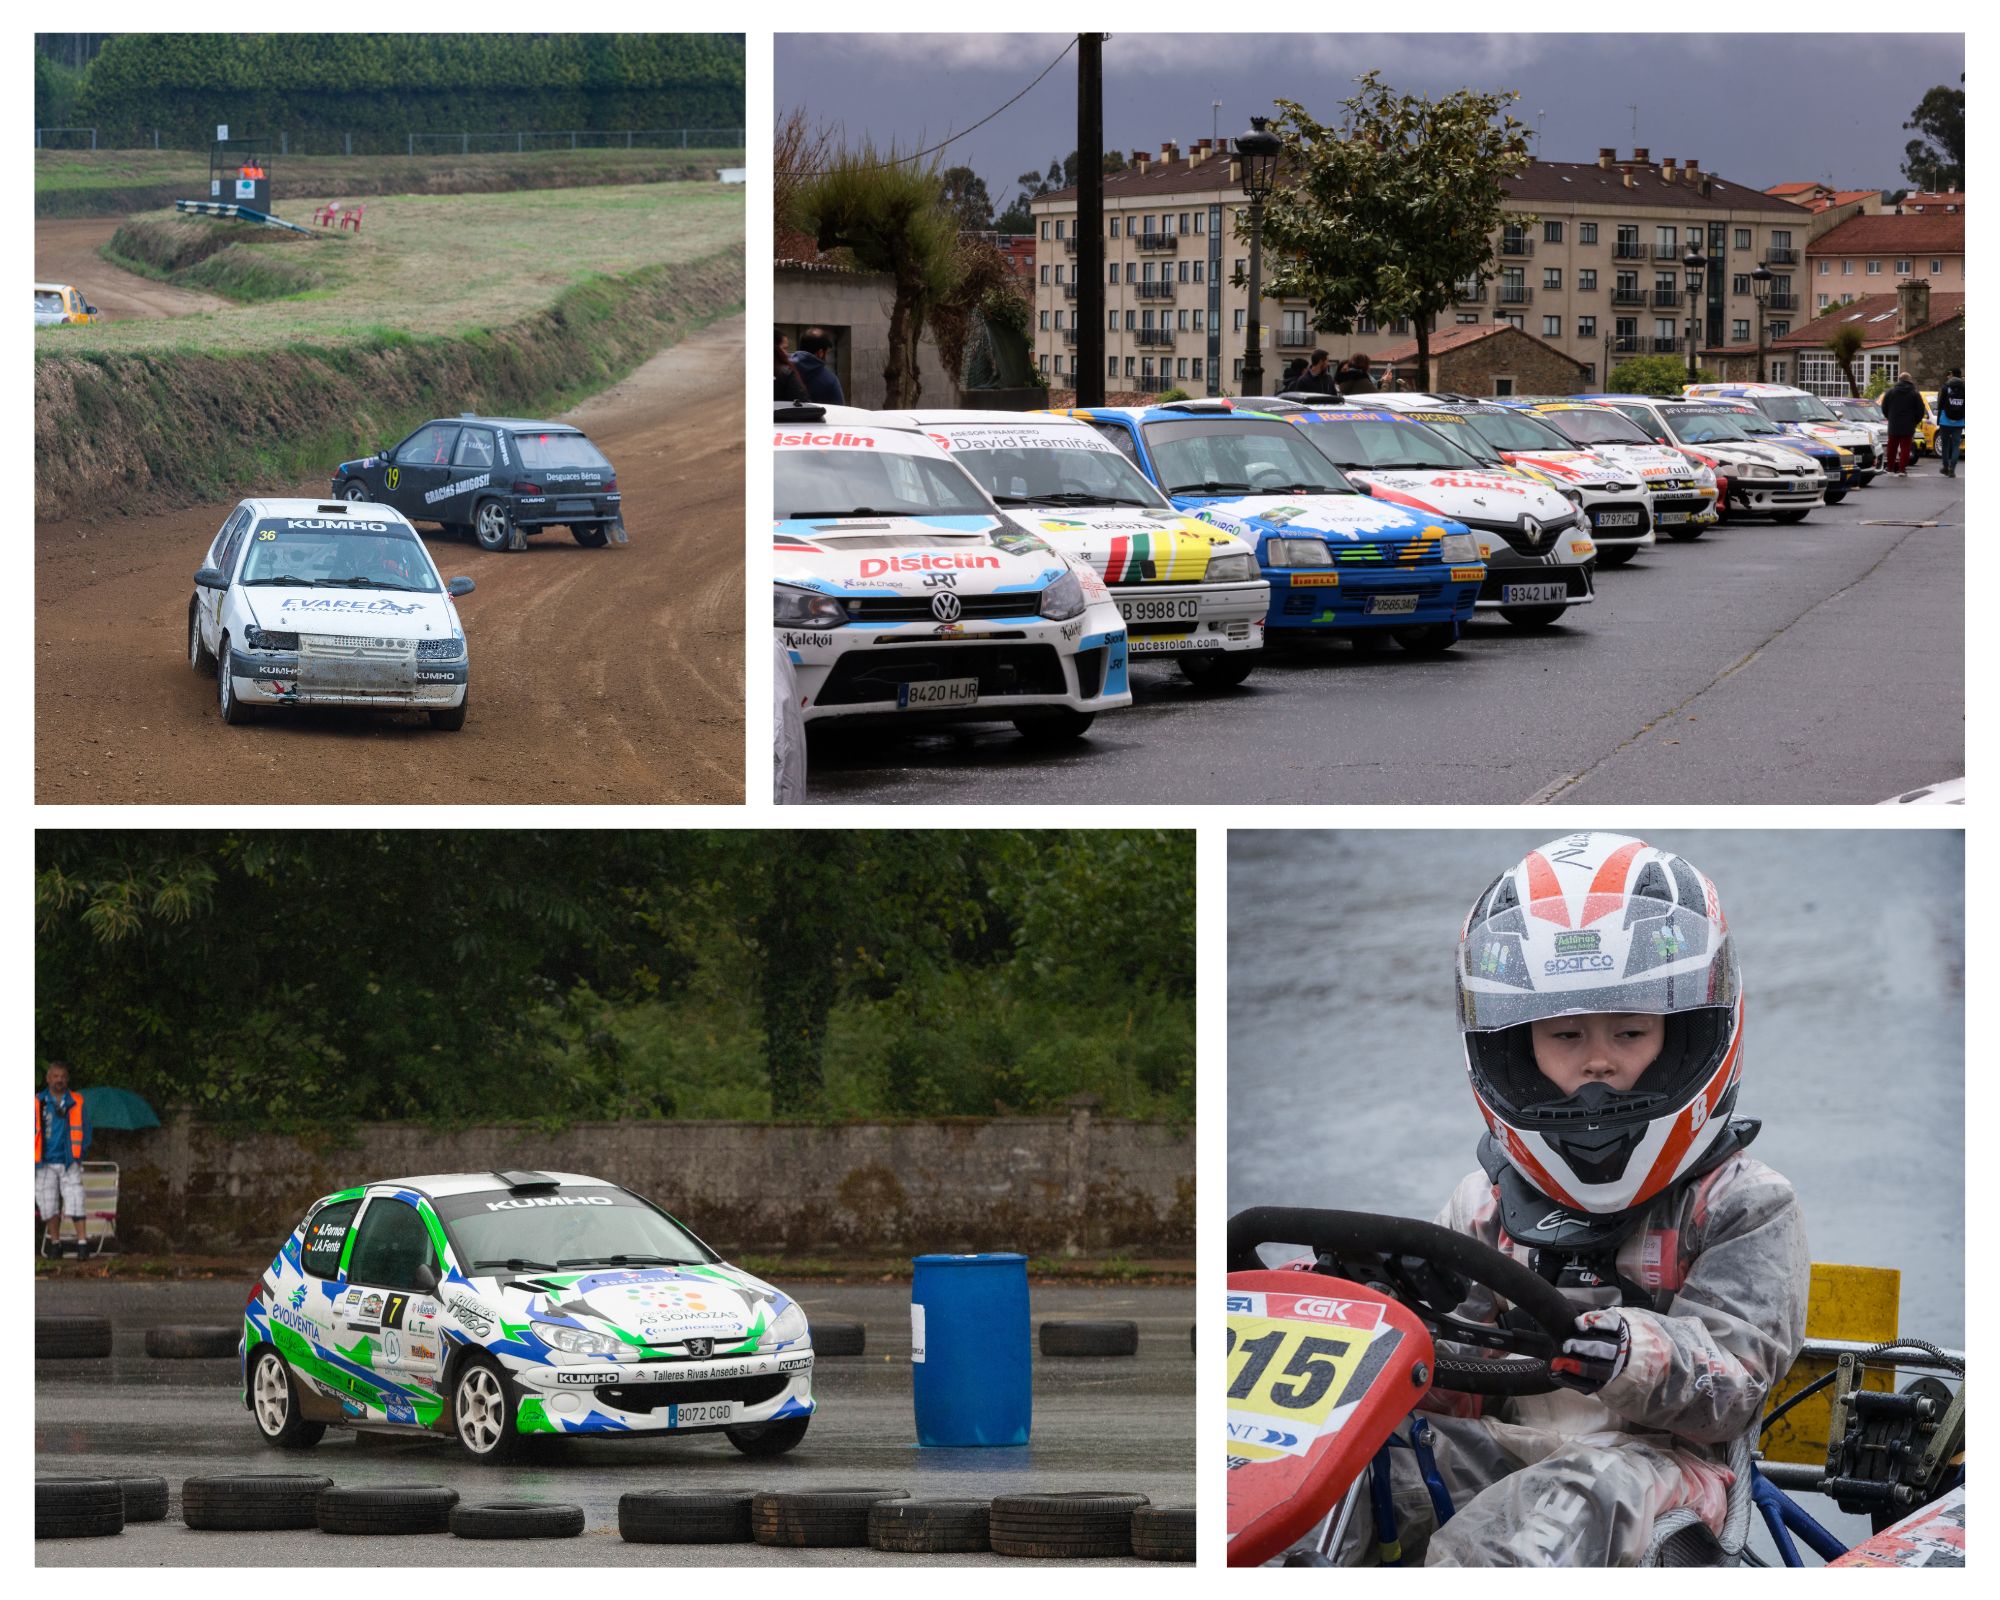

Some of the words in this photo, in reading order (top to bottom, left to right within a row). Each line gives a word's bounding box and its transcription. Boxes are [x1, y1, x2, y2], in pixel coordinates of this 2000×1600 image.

[1317, 412, 1381, 422] Recalvi
[774, 433, 875, 449] isiclin
[953, 436, 1018, 450] David
[388, 467, 399, 488] 19
[546, 472, 580, 482] Desguaces
[1642, 466, 1690, 477] autofull
[424, 484, 456, 504] GRACIAS
[455, 473, 490, 495] AMIGOS!!
[287, 520, 388, 532] KUMHO
[1600, 513, 1621, 525] 3797
[258, 530, 277, 541] 36
[859, 553, 1001, 579] Disiclin
[922, 573, 957, 588] JRT
[1293, 575, 1337, 584] PIRELLI
[1452, 569, 1484, 579] PIRELLI
[1511, 587, 1540, 601] 9342
[1543, 586, 1564, 599] LMY
[1136, 601, 1175, 619] 9988
[1178, 600, 1197, 617] CD
[783, 632, 833, 648] Kalekói
[909, 684, 946, 702] 8420
[949, 682, 977, 699] HJR
[1544, 955, 1614, 973] sparco
[1691, 1094, 1708, 1132] 8
[486, 1197, 614, 1211] KUMHO
[318, 1223, 346, 1237] A.Fornos
[311, 1239, 341, 1253] J.A.Fente
[391, 1297, 402, 1324] 7
[1294, 1298, 1353, 1321] CGK
[447, 1298, 491, 1338] TRIGO
[639, 1316, 658, 1325] AS
[660, 1311, 739, 1322] SOMOZAS
[780, 1360, 813, 1370] KUMHO
[1227, 1327, 1351, 1409] 15
[558, 1374, 618, 1383] KUMHO
[653, 1369, 685, 1381] Talleres
[687, 1368, 709, 1379] Rivas
[710, 1367, 739, 1378] Ansede
[740, 1365, 753, 1376] S.L.
[678, 1410, 707, 1422] 9072
